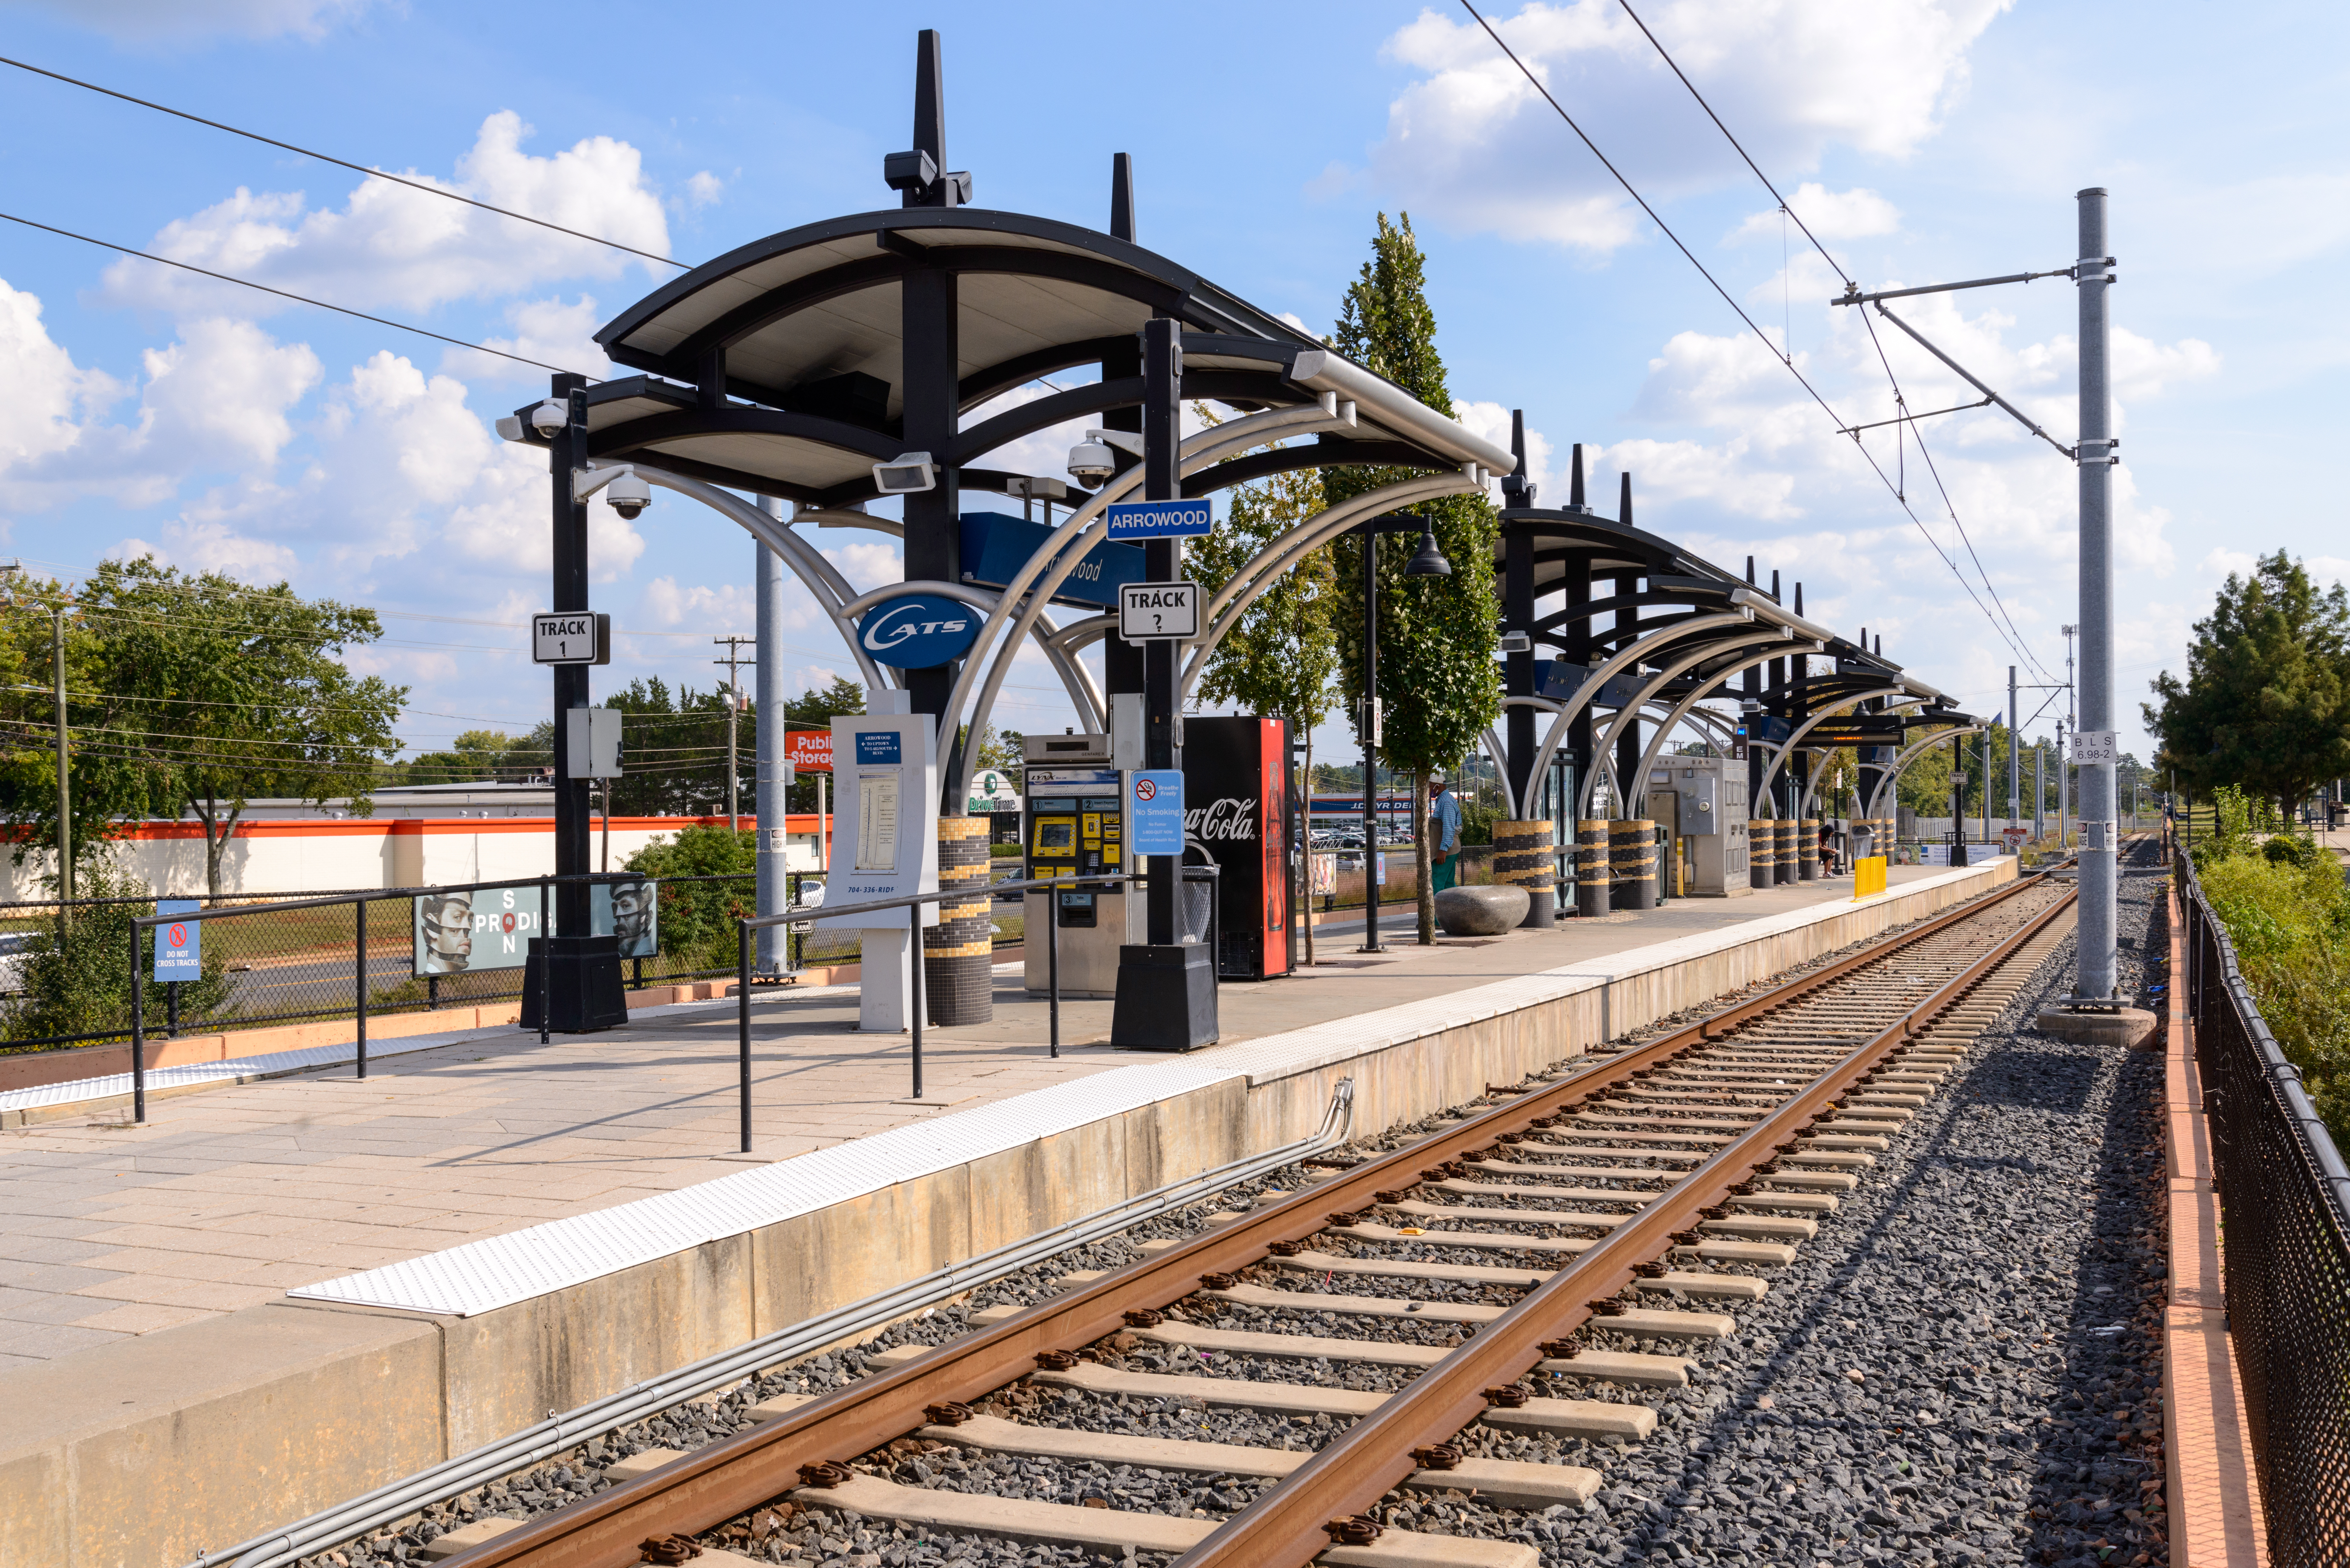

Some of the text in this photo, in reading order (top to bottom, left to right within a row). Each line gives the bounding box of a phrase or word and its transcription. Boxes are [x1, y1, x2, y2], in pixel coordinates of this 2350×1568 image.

[1111, 510, 1207, 528] ARROWOOD
[1129, 592, 1185, 608] TRACK
[540, 621, 586, 636] TRACK
[864, 604, 967, 650] CATS
[559, 641, 565, 655] 1
[2075, 737, 2111, 747] B L S
[2078, 750, 2109, 759] 6.98-2
[969, 795, 1015, 811] DriveTime
[1147, 808, 1180, 817] Smoking
[772, 840, 782, 848] HIGH
[476, 911, 556, 934] PRODI
